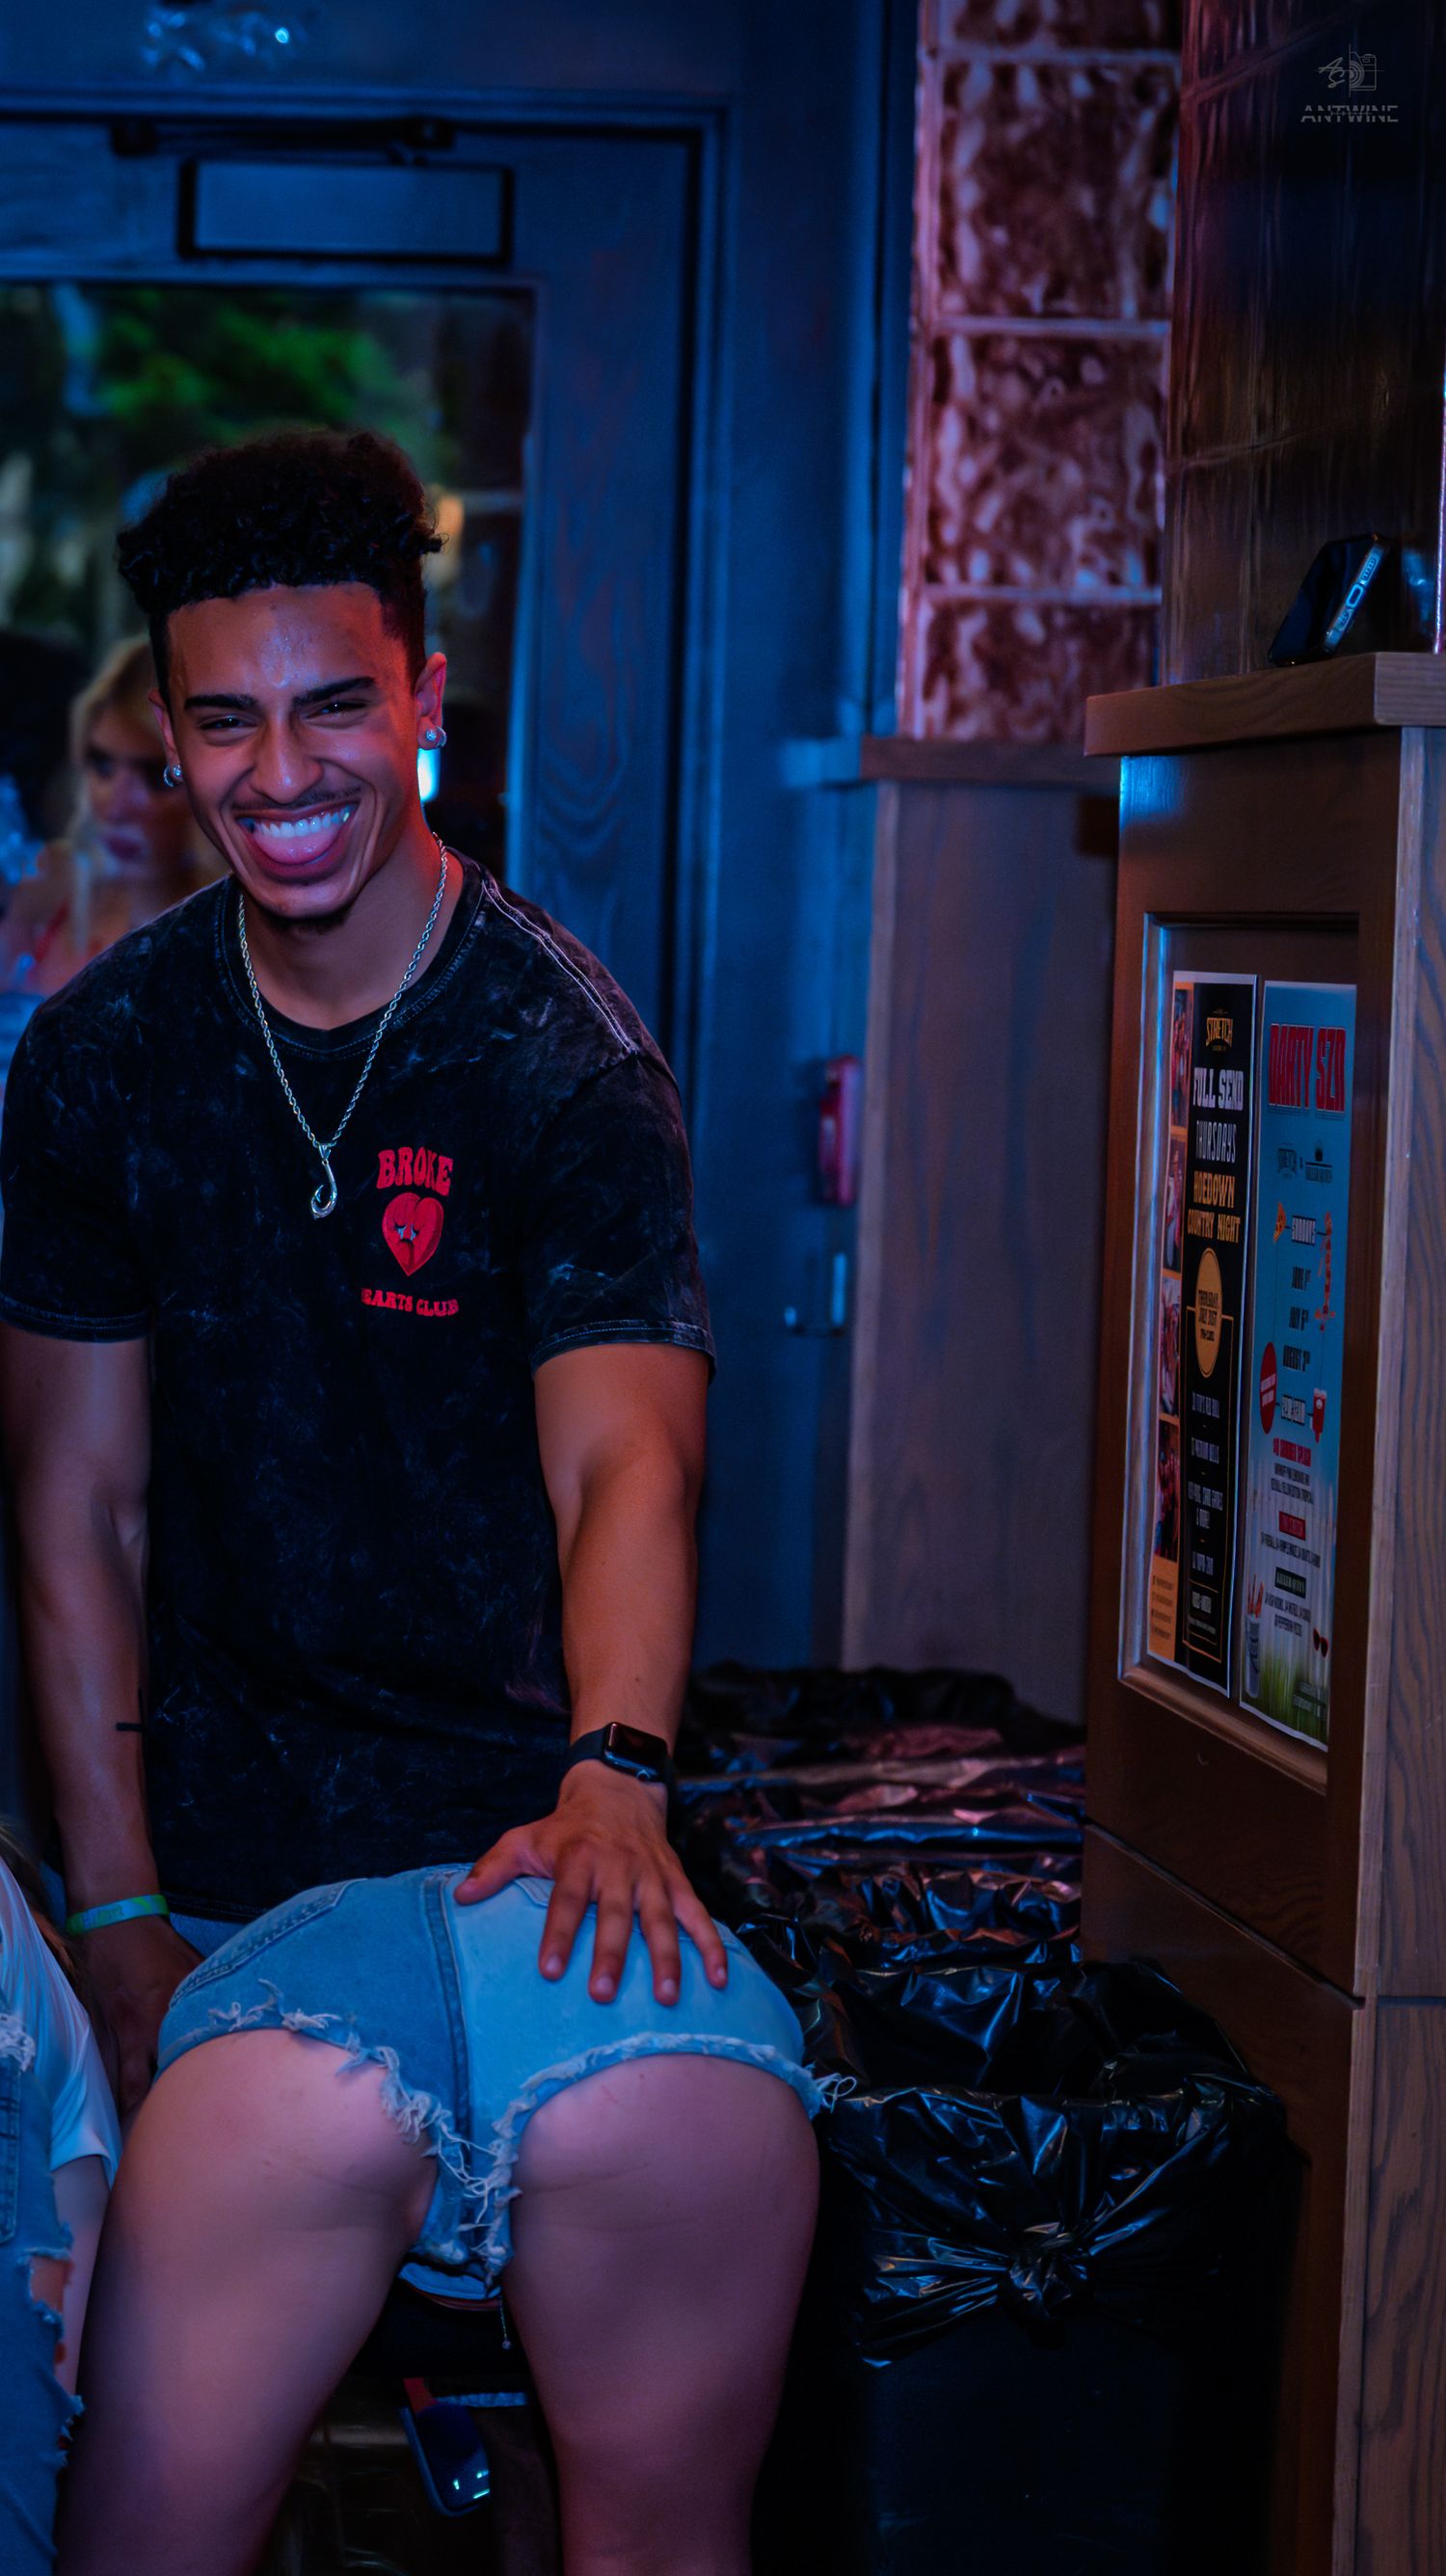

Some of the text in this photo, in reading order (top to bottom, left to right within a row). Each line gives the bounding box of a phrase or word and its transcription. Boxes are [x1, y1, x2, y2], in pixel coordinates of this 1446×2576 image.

[1205, 1016, 1233, 1048] STRETCH
[1268, 1024, 1314, 1109] DARTY
[1192, 1067, 1244, 1111] FULL SEND
[1195, 1119, 1236, 1164] THURSDAYS
[376, 1146, 454, 1196] BROKE
[1193, 1169, 1235, 1208] HOEDOWN
[1187, 1208, 1241, 1244] COUNTRY NIGHT
[415, 1299, 460, 1318] CLUB
